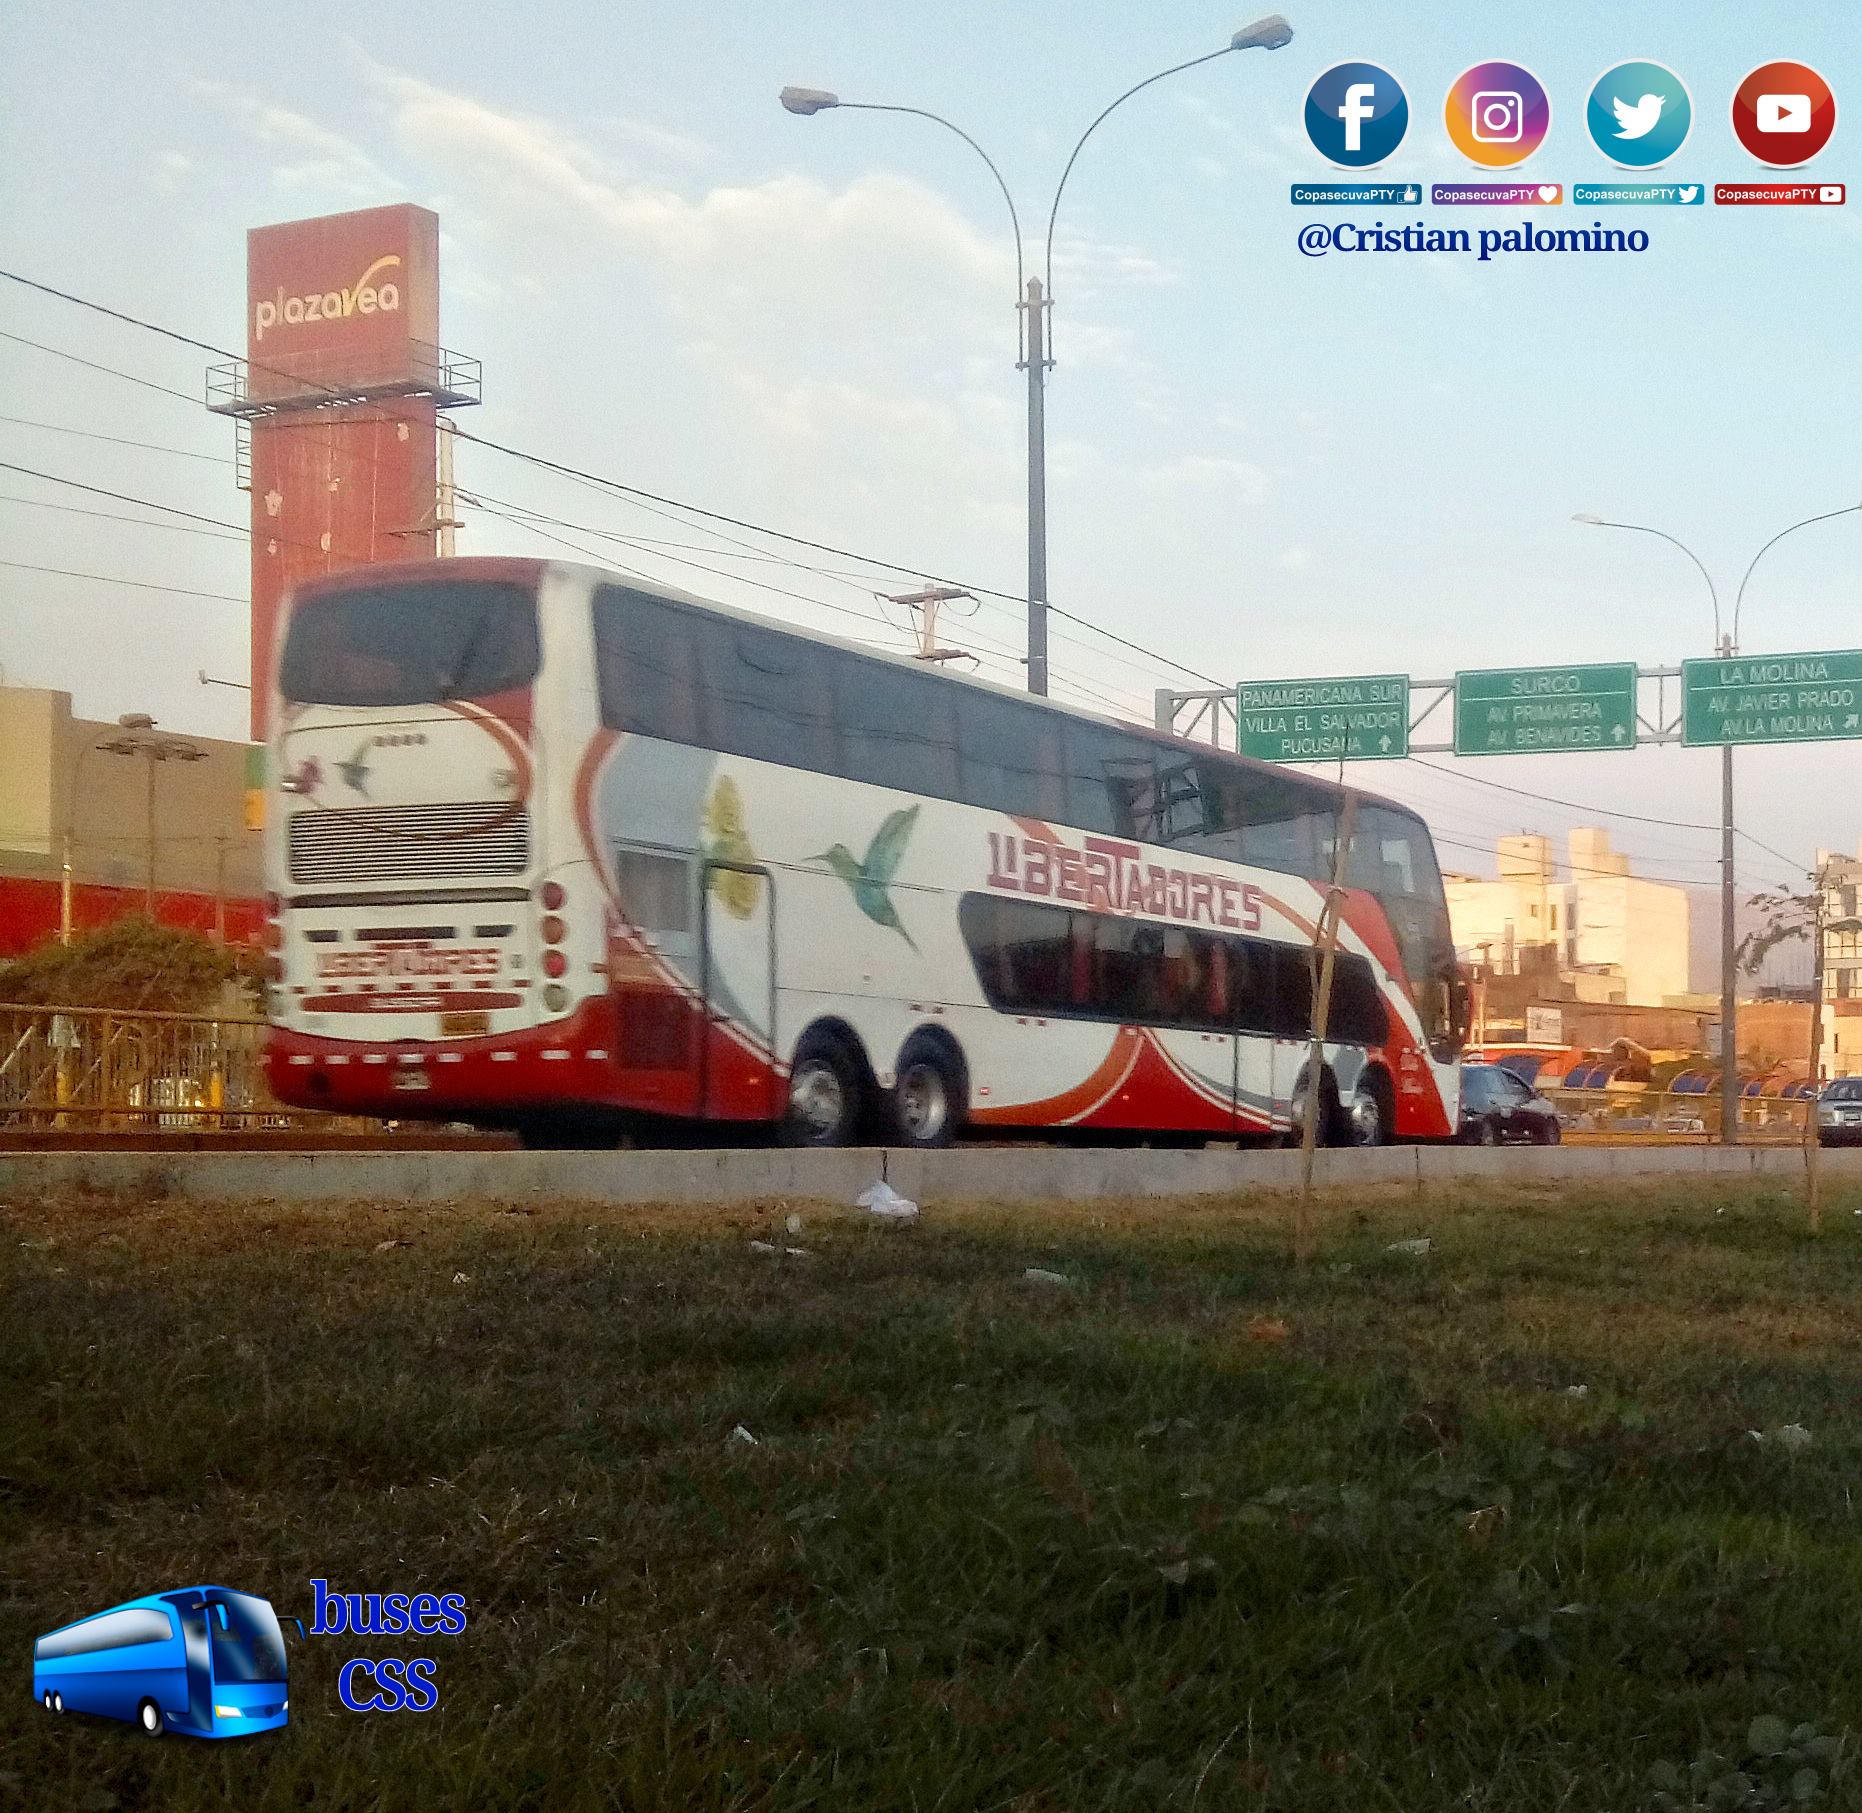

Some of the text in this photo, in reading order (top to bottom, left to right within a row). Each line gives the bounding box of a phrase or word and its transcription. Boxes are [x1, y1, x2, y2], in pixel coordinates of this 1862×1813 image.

[1511, 675, 1581, 694] SURCO
[1720, 662, 1829, 685] LA MOLINA
[1241, 684, 1401, 707] PANAMERICANA SUR
[1736, 692, 1791, 711] JAVIER
[1798, 689, 1854, 708] PRADO
[1246, 712, 1401, 733] VILLA EL SALVADOR
[1746, 716, 1766, 734] LA
[1770, 713, 1833, 733] MOLINA
[987, 831, 1264, 932] LIBERTADORES
